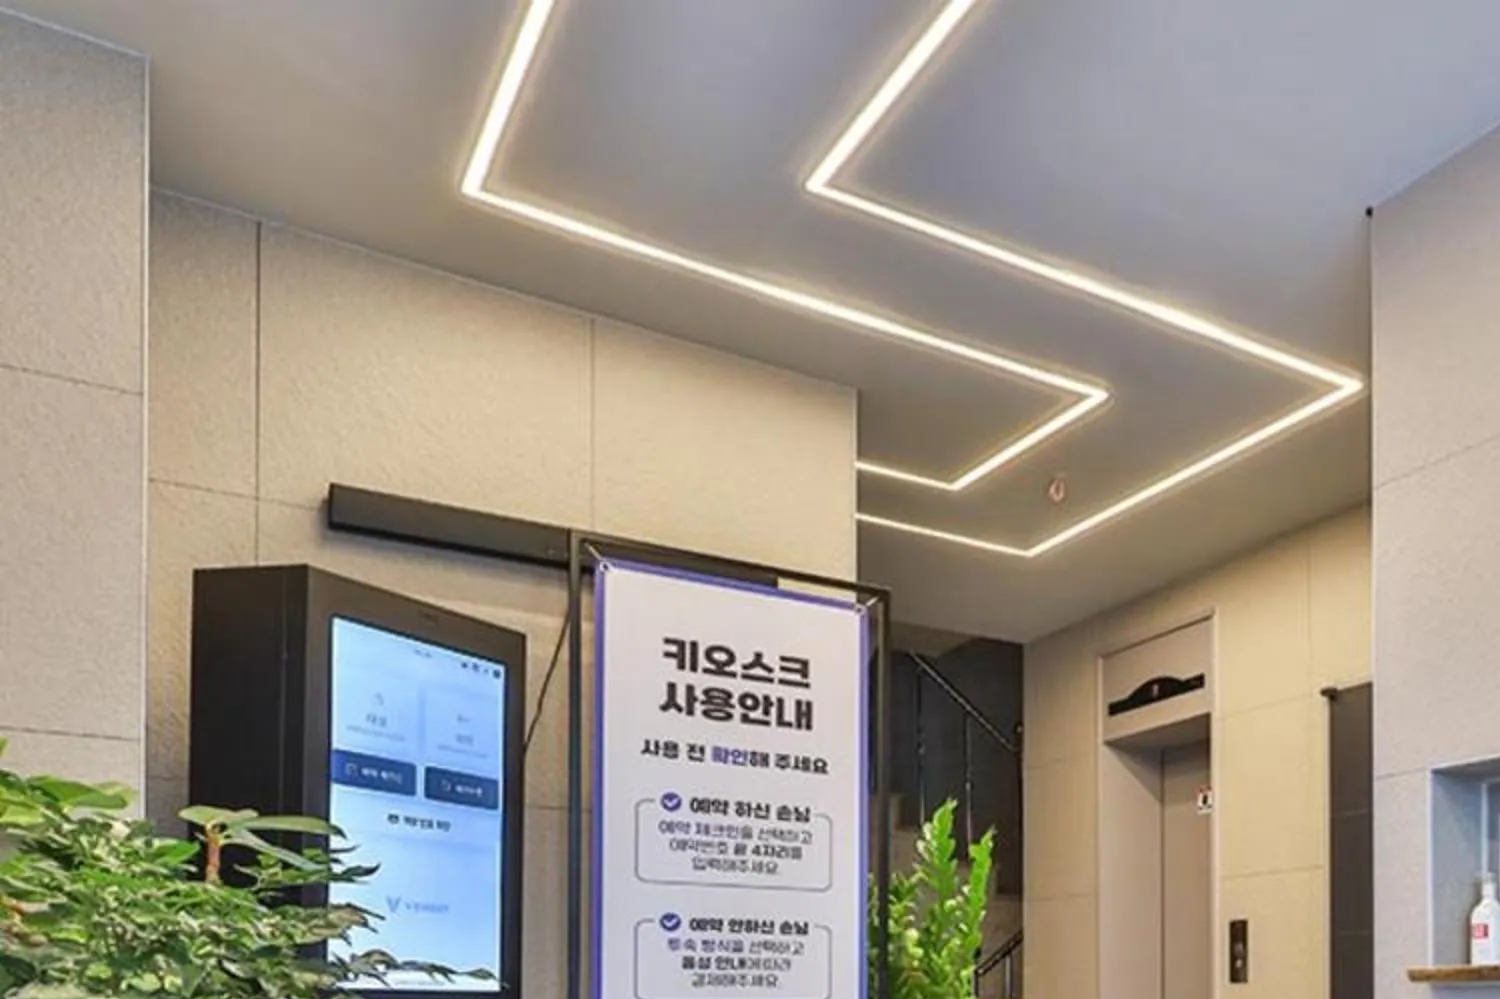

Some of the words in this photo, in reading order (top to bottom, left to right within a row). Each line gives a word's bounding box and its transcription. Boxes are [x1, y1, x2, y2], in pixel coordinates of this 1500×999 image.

[662, 637, 811, 689] 키오스크
[659, 682, 814, 731] 사용안내
[641, 739, 680, 760] 사용
[686, 744, 705, 762] 전
[711, 746, 770, 768] 확인해
[774, 754, 829, 775] 주세요
[690, 797, 729, 816] 예약
[734, 801, 770, 820] 하신
[776, 805, 811, 823] 손님
[658, 820, 691, 834] 예약
[689, 918, 724, 933] 예약
[728, 918, 775, 935] 안하신
[779, 920, 809, 935] 손님
